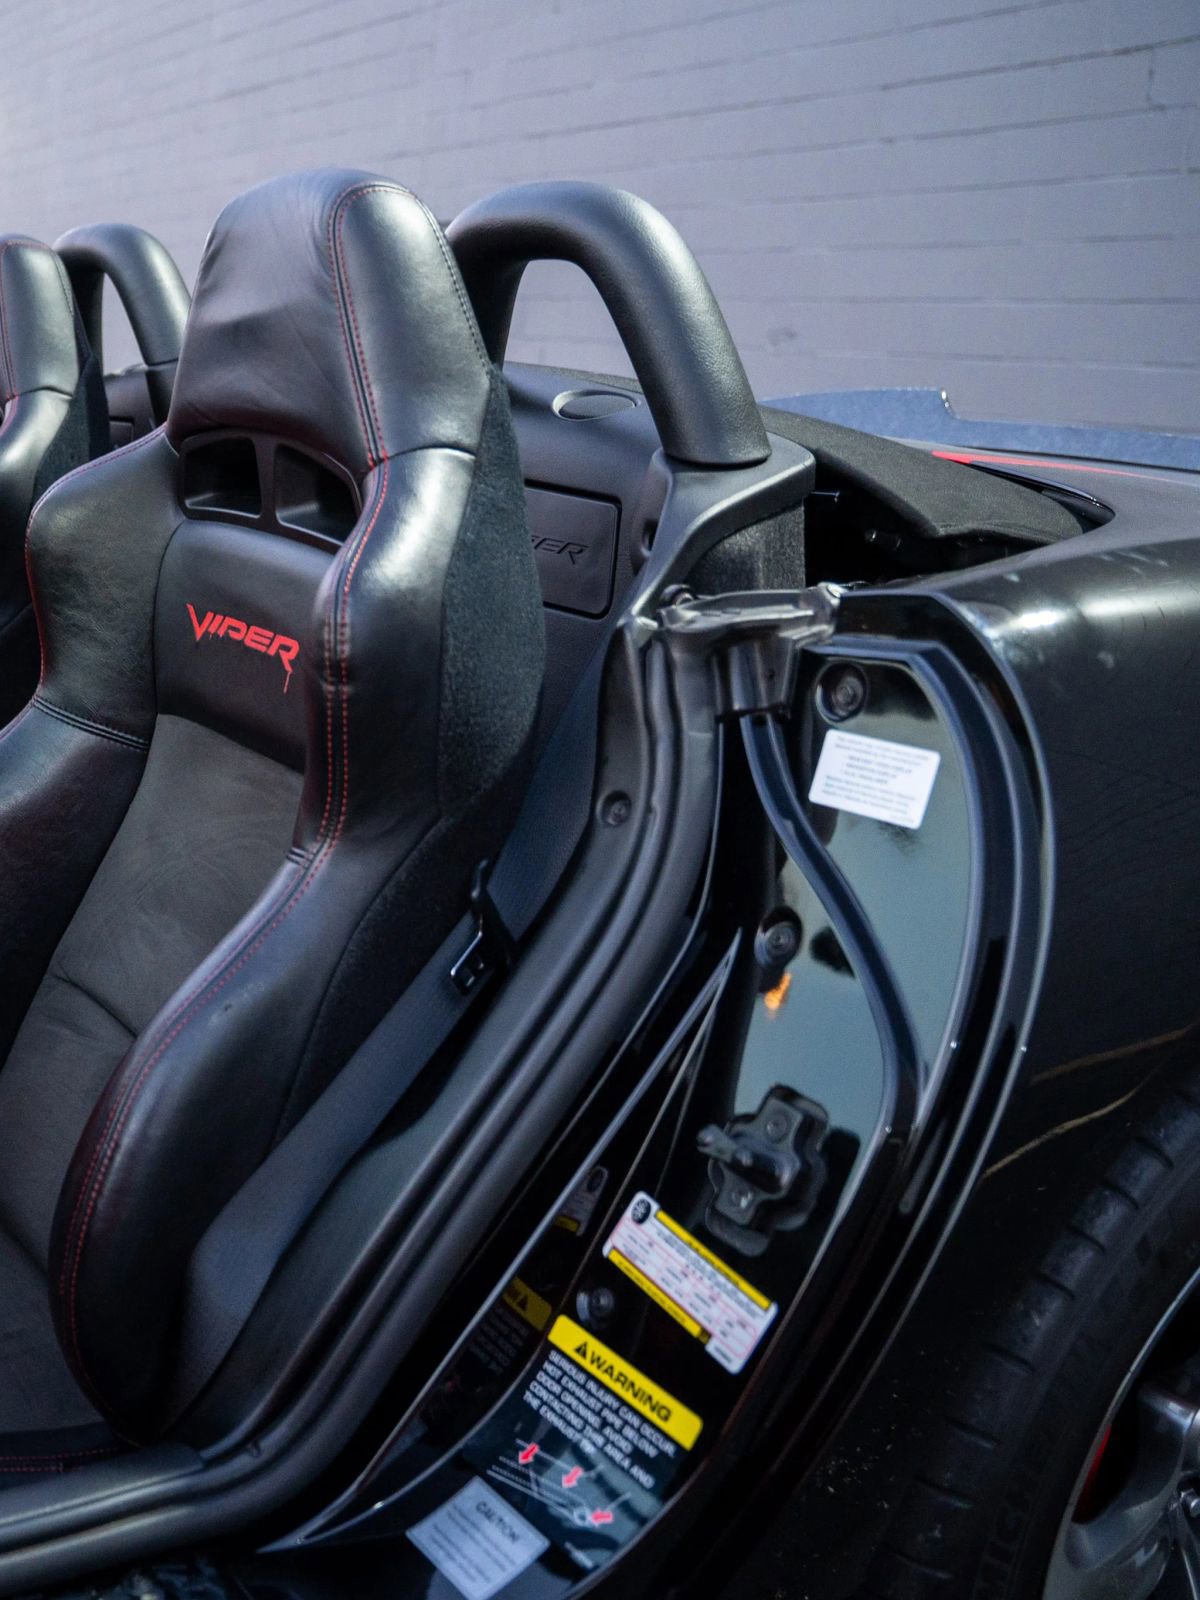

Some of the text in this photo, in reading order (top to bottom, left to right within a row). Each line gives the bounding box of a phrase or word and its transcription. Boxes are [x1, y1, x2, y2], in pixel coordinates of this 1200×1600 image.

[187, 603, 300, 692] VIPER
[547, 1349, 588, 1384] SERIOUS
[617, 1404, 642, 1428] CAN
[586, 1351, 673, 1422] WARNING
